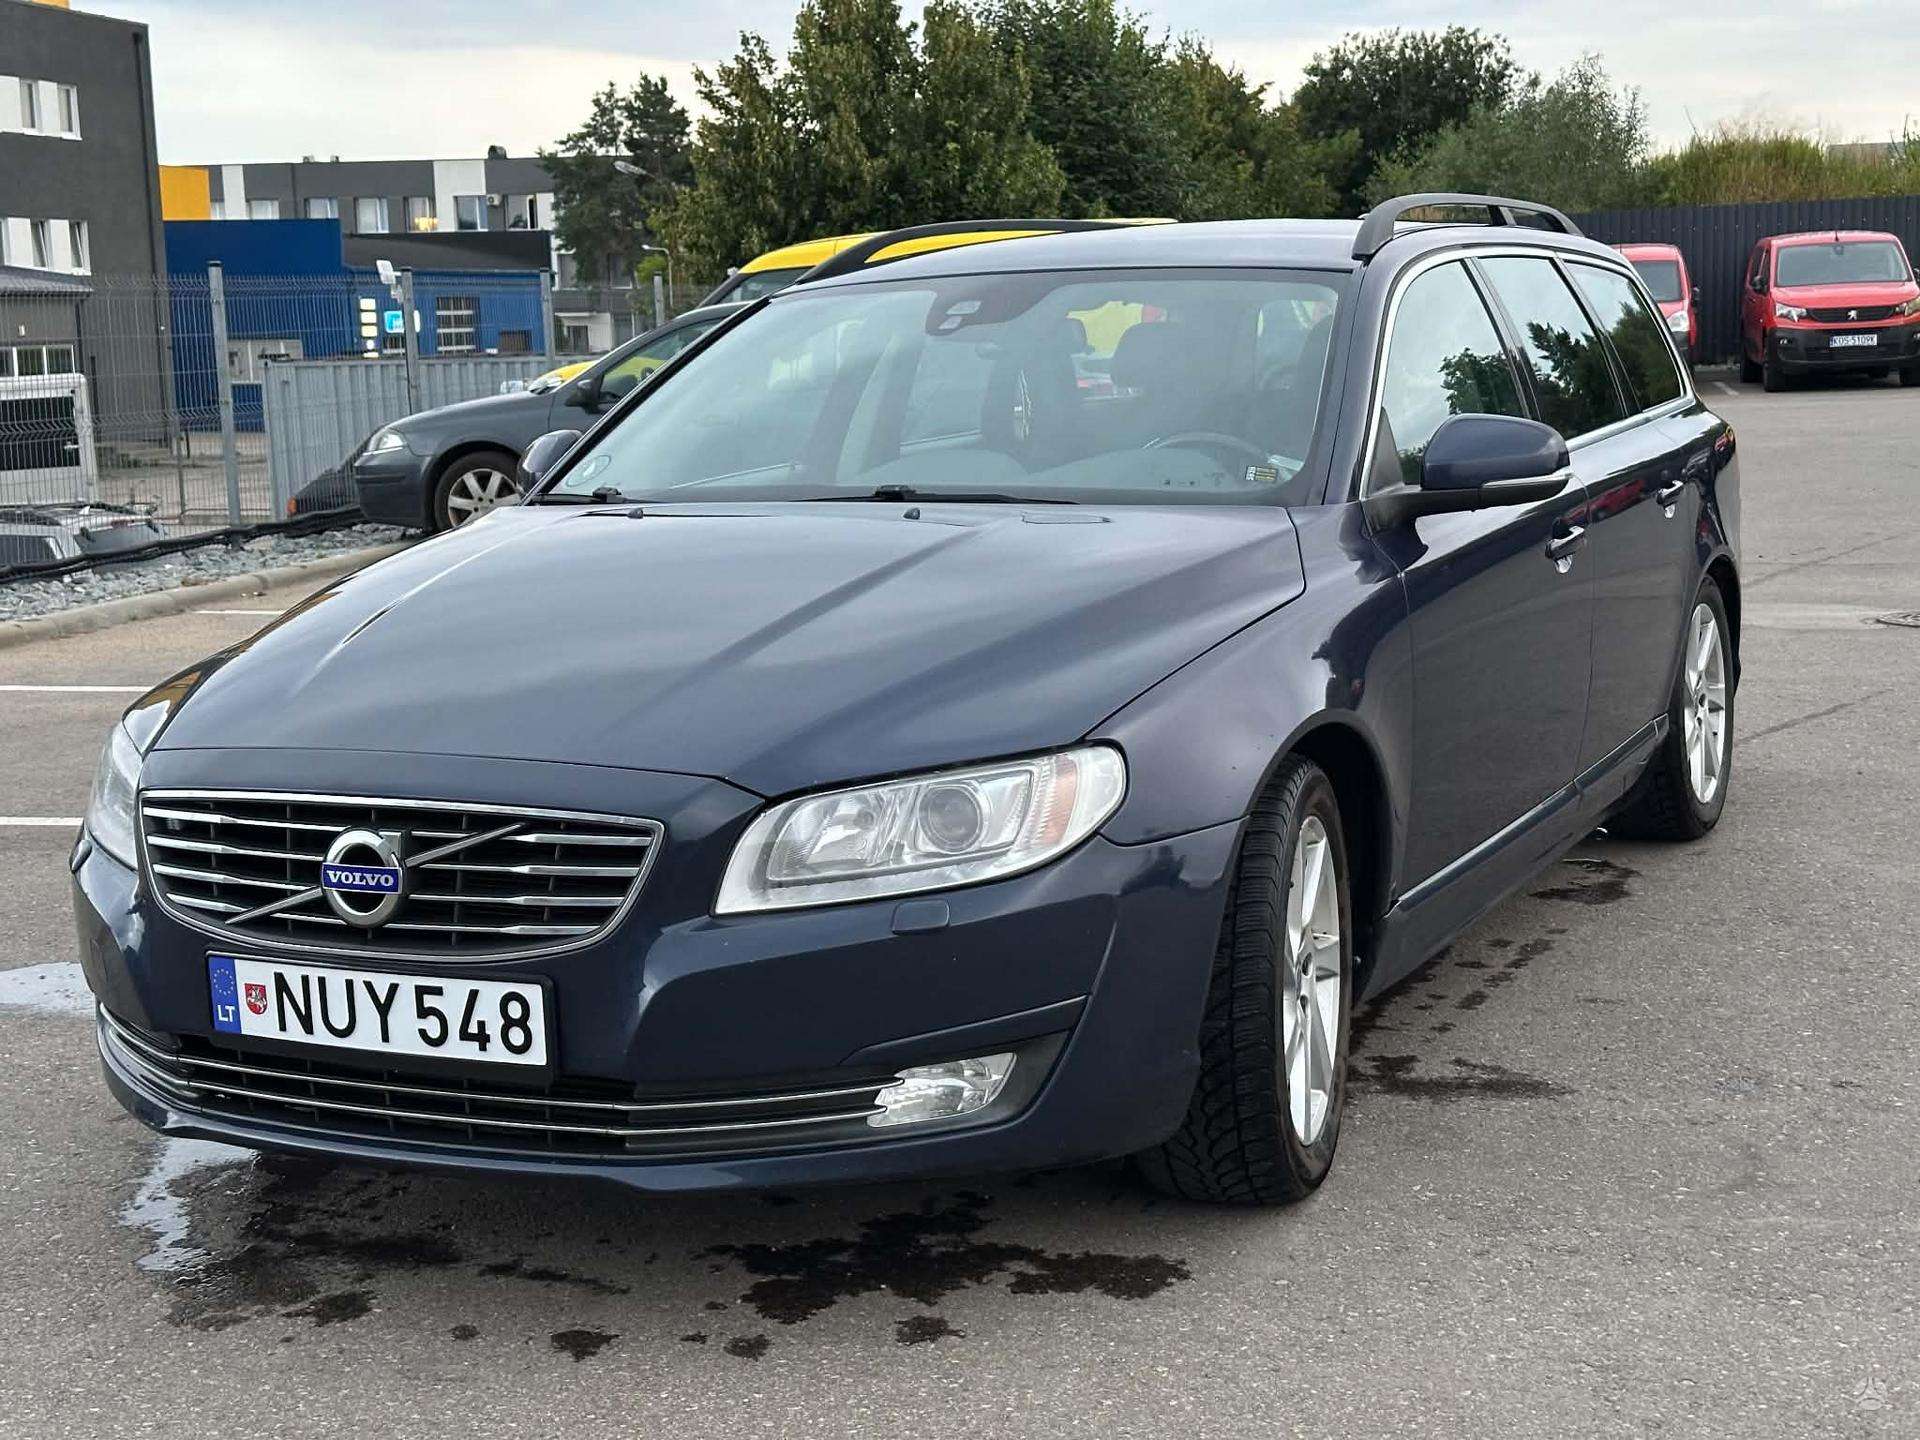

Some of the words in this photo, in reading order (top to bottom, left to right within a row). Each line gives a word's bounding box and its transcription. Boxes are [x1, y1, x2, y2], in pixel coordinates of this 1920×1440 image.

[326, 869, 395, 887] VOLVO
[216, 1004, 236, 1022] LT
[273, 971, 400, 1043] NUY
[414, 984, 533, 1055] 548
